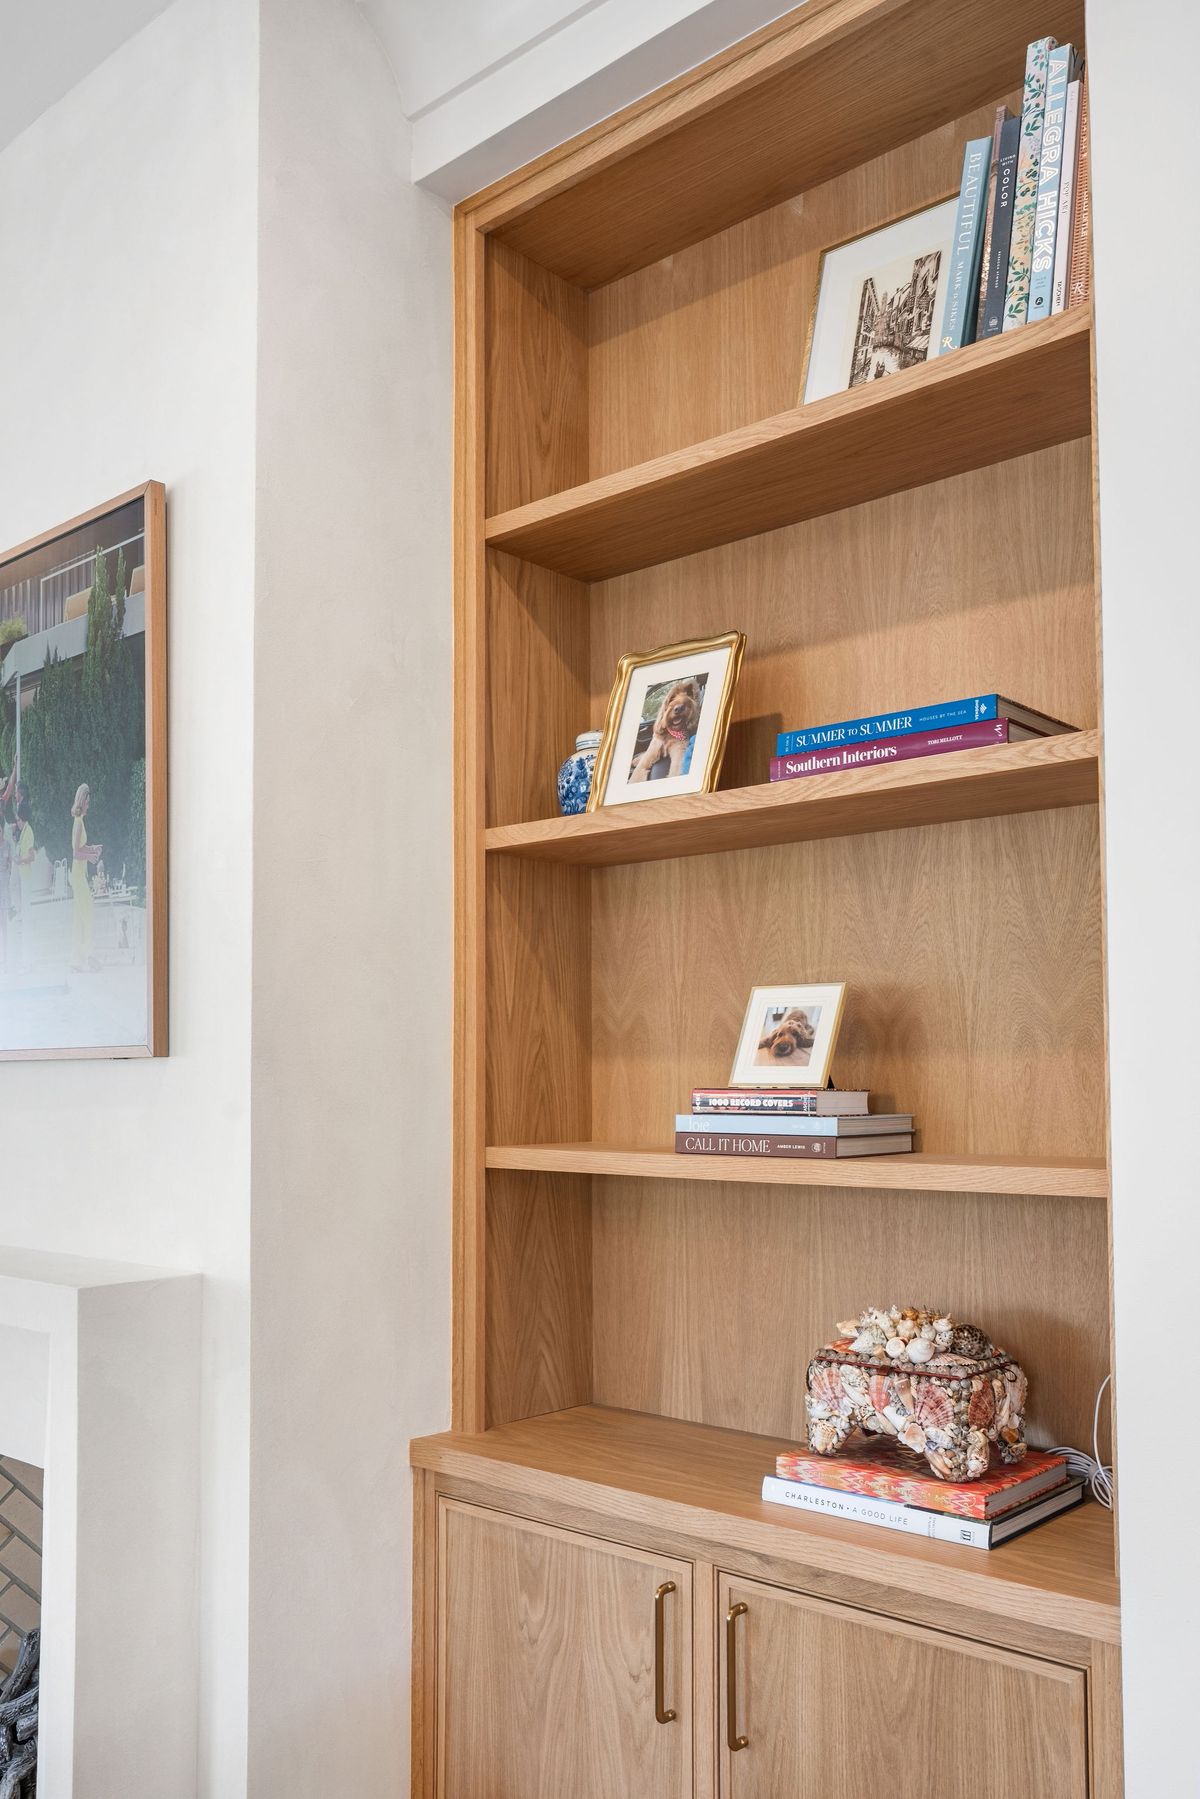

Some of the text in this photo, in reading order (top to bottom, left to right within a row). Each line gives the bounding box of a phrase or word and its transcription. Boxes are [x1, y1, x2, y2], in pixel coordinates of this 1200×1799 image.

[1040, 60, 1067, 186] ALLEGRA
[957, 152, 982, 256] BEAUTIFUL
[1000, 168, 1011, 208] COLOR
[1033, 191, 1057, 273] HICKS
[953, 261, 964, 291] MARK
[950, 301, 960, 331] SIKES
[796, 728, 845, 748] SUMMER
[859, 716, 913, 736] SUMMER
[919, 714, 938, 722] HOUSES
[957, 709, 967, 717] SEA
[785, 751, 840, 775] Southern
[843, 744, 897, 765] Interiors
[928, 738, 940, 746] TORI
[940, 734, 964, 744] MELLOTT
[708, 1097, 729, 1108] 1000
[730, 1097, 762, 1108] RECORD
[762, 1098, 794, 1108] COVERS
[687, 1117, 710, 1132] Joie
[685, 1137, 717, 1152] CALL
[718, 1138, 730, 1151] IT
[732, 1138, 771, 1153] HOME
[785, 1491, 909, 1526] CHARLESTON A GOOD LIFE
